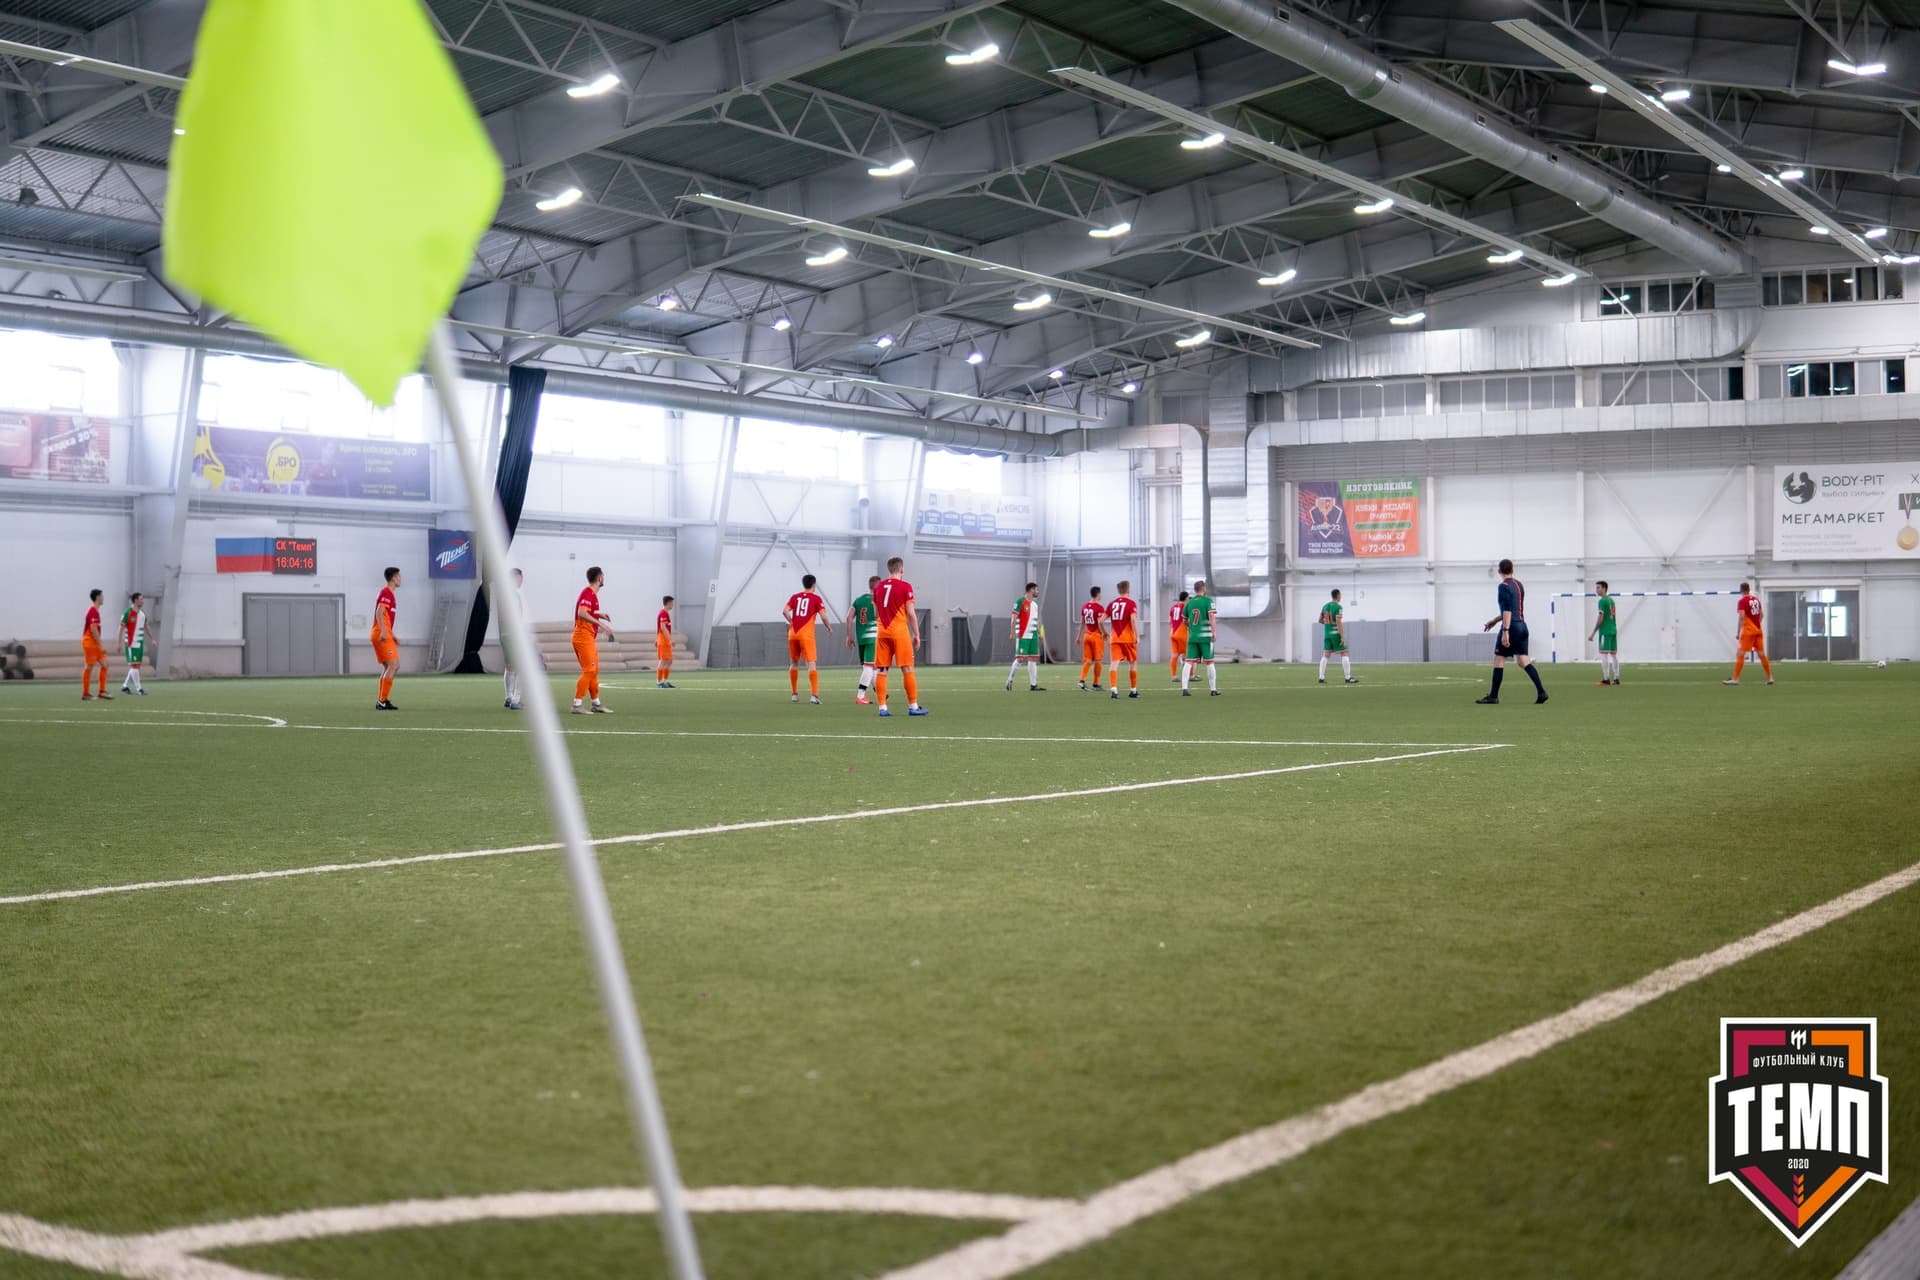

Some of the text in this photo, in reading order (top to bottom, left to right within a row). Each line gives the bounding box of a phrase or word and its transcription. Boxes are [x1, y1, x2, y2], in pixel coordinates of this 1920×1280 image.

[1821, 474, 1885, 487] BODY-PIT
[1781, 512, 1885, 525] МЕГАМАРКЕТ
[276, 541, 286, 551] СК
[883, 584, 892, 608] 7
[796, 597, 810, 617] 19
[1112, 602, 1126, 620] 27
[1749, 599, 1760, 616] 33
[859, 607, 868, 625] 5
[1083, 608, 1095, 625] 23
[1192, 609, 1201, 626] 7
